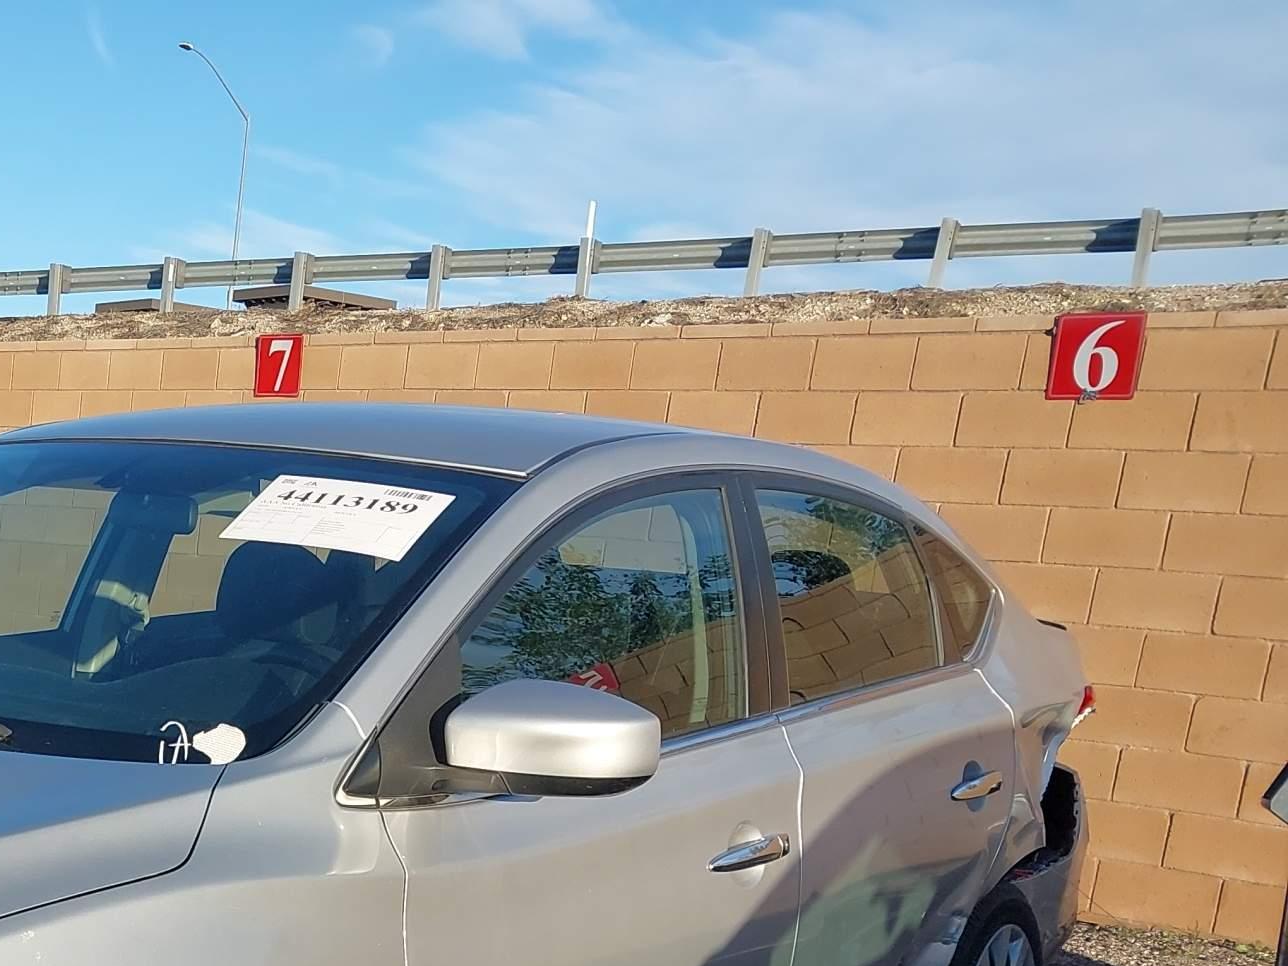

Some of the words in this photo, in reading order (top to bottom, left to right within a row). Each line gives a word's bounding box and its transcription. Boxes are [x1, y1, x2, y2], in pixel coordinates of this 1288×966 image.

[268, 339, 296, 391] 7
[1073, 320, 1126, 391] 6
[277, 488, 420, 515] 44113189
